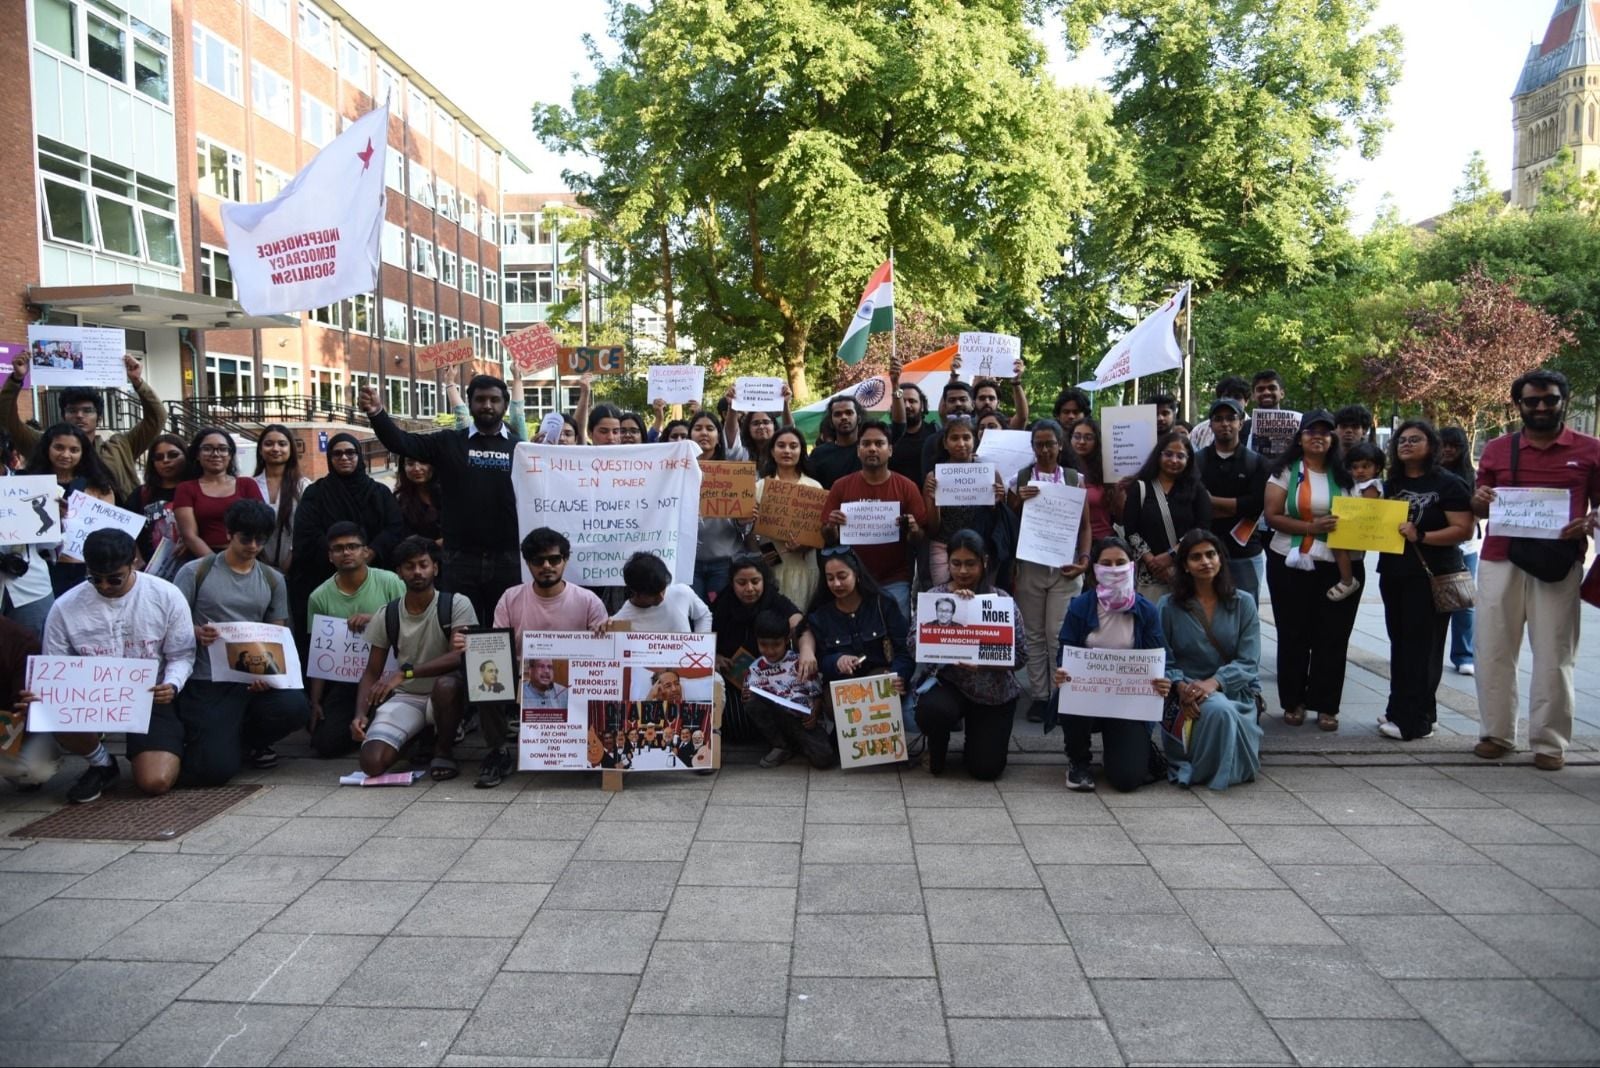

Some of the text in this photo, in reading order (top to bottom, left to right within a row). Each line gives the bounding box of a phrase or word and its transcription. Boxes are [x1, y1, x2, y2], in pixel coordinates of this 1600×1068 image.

[963, 335, 980, 344] SAVE
[469, 450, 510, 460] BOSTON
[526, 456, 542, 473] I
[551, 457, 584, 472] WILL
[591, 458, 652, 475] QUESTION
[660, 458, 692, 470] THOSE
[941, 466, 989, 474] CORRUPTED
[578, 478, 646, 488] IN POWER
[768, 482, 796, 494] ABEY
[700, 488, 718, 498] etter
[722, 488, 738, 498] than
[534, 497, 679, 512] BECAUSE POWER IS NOT
[706, 498, 742, 516] NTA
[92, 503, 132, 524] MURDERER
[84, 516, 96, 526] OF
[578, 530, 662, 544] ACCOUNTABILITY
[668, 532, 678, 542] IS
[577, 550, 628, 562] OPTIONAL
[583, 567, 625, 580] DEMOC
[982, 600, 992, 610] NO
[982, 610, 1010, 623] MORE
[321, 620, 334, 637] 3
[314, 637, 370, 653] 12 YEA
[344, 656, 367, 668] PRE
[978, 651, 1012, 662] MURDERS
[1066, 648, 1162, 664] THE EDUCATION MINISTER
[1087, 662, 1114, 671] SHOULD
[93, 665, 124, 682] DAY
[129, 668, 152, 684] OF
[1089, 676, 1122, 686] STUDENTS
[40, 686, 136, 704] HUNGER
[835, 681, 874, 706] FROM
[59, 706, 132, 724] STRIKE
[844, 708, 862, 724] TO
[842, 728, 858, 738] WE
